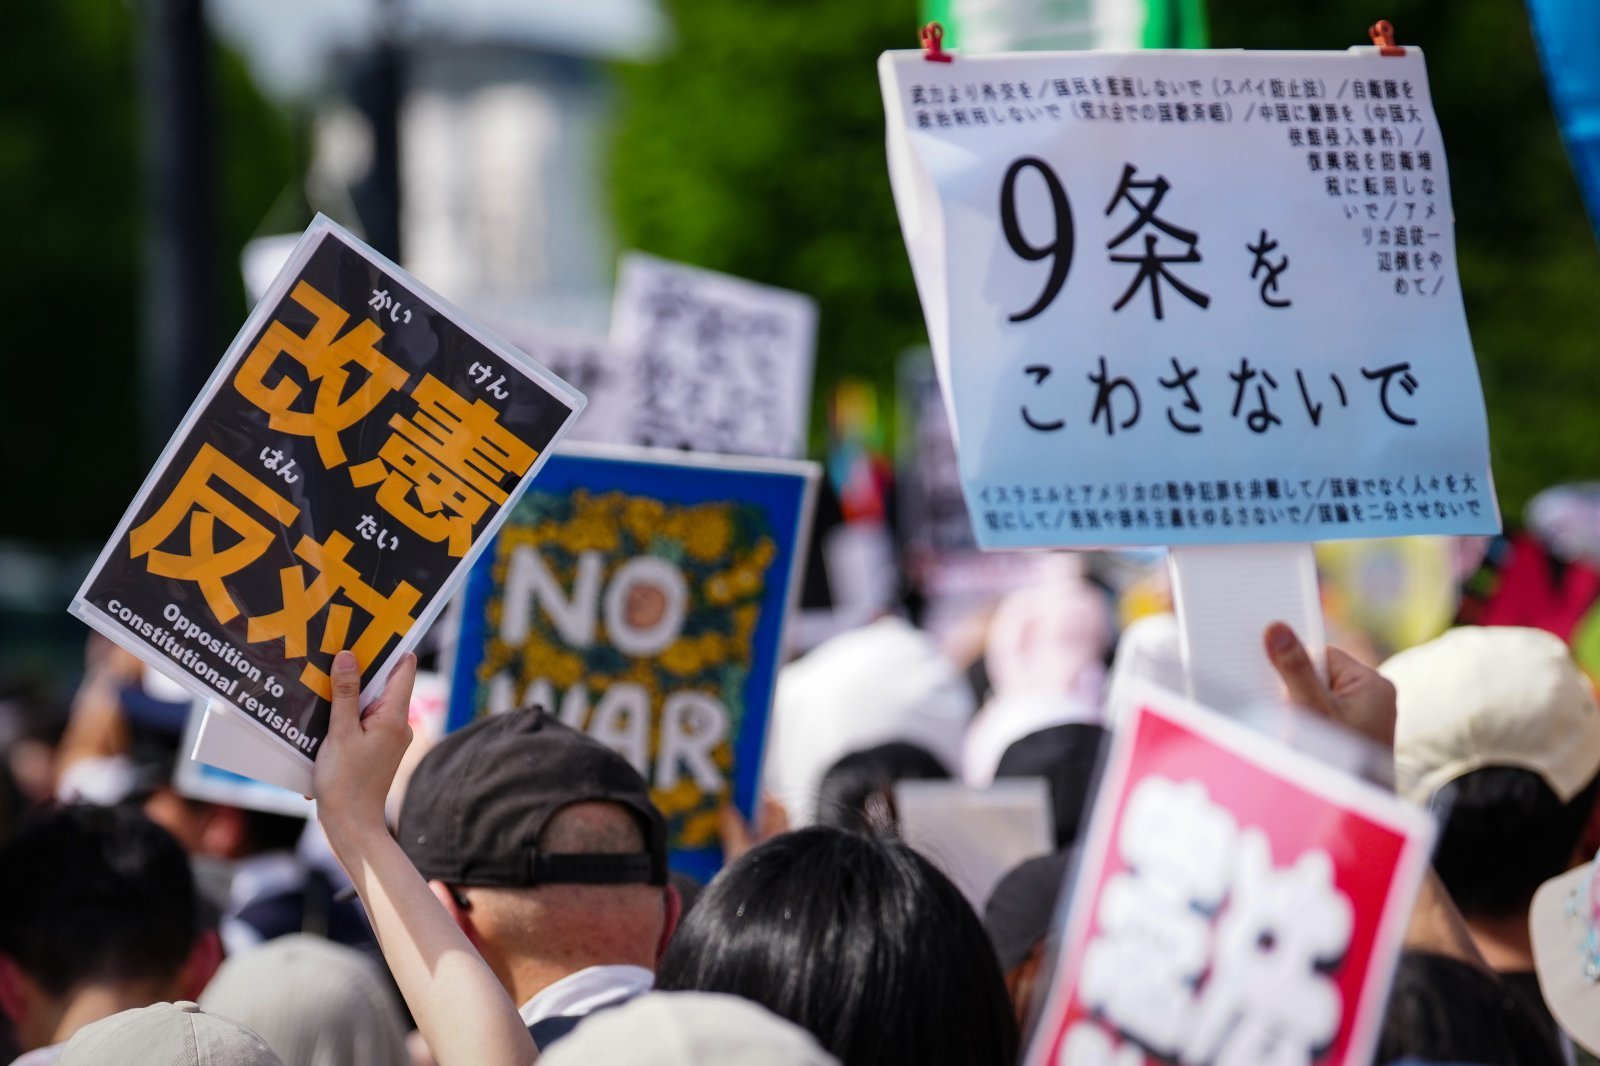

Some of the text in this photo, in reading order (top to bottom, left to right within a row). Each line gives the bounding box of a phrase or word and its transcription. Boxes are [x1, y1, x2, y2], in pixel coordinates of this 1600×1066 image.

[1325, 175, 1436, 197] 税に転用しな
[1377, 250, 1443, 272] 辺倒をや
[369, 288, 413, 325] かい
[468, 360, 509, 400] けん
[1021, 355, 1419, 436] こわさないで
[233, 279, 539, 559] 改憲
[259, 445, 300, 485] はん
[354, 513, 400, 552] たい
[128, 443, 424, 704] 反対
[499, 543, 691, 659] NO
[106, 597, 318, 753] constitutional revision!
[163, 602, 285, 699] Opposition to
